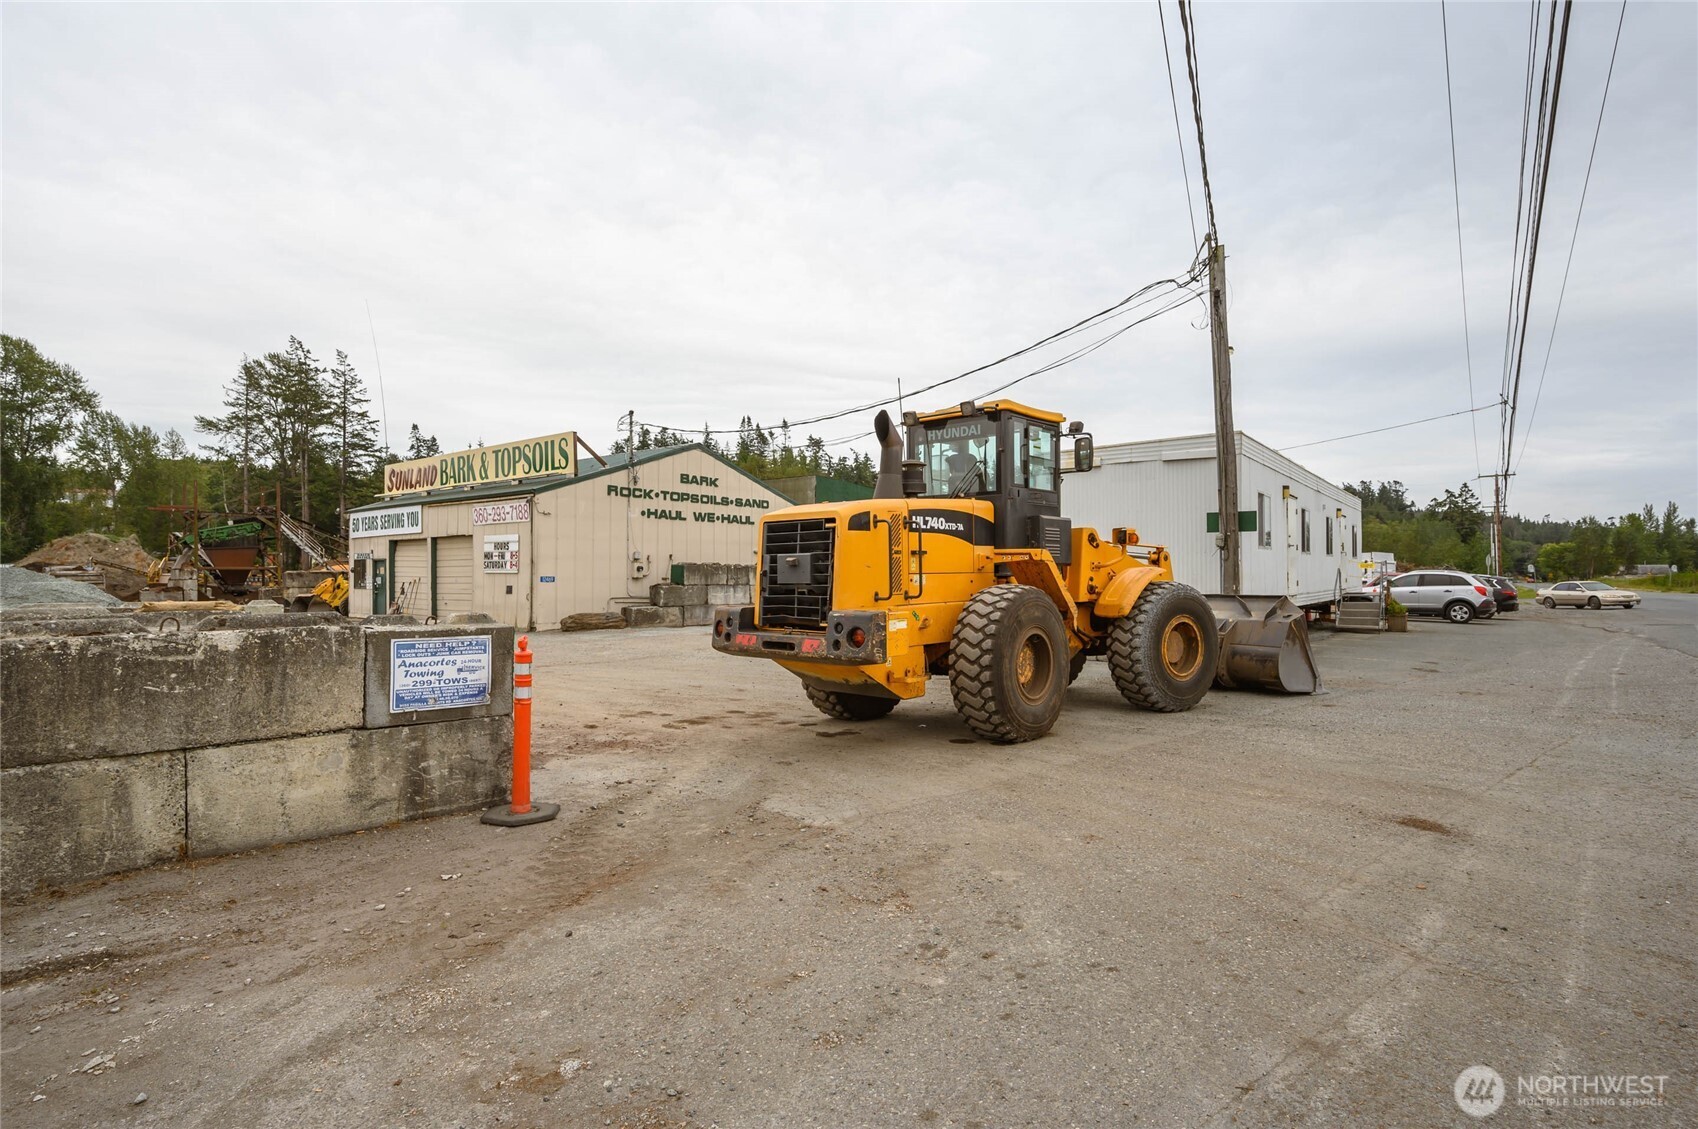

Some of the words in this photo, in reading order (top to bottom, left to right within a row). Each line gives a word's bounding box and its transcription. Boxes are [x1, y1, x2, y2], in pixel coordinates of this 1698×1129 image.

[928, 424, 981, 441] HYUNDAI
[387, 465, 438, 493] SUNLAND
[440, 453, 476, 486] BARK
[479, 452, 490, 480] &
[492, 437, 570, 479] TOPSOILS
[680, 473, 719, 488] BARK
[473, 503, 529, 524] 360-293-7188
[352, 517, 360, 533] 50
[360, 515, 379, 532] YEARS
[379, 511, 405, 531] SERVING
[406, 510, 420, 528] YOU
[493, 541, 510, 551] HOURS
[483, 560, 508, 570] SATURDAY
[397, 658, 458, 669] Anacortes
[403, 669, 445, 679] Towing
